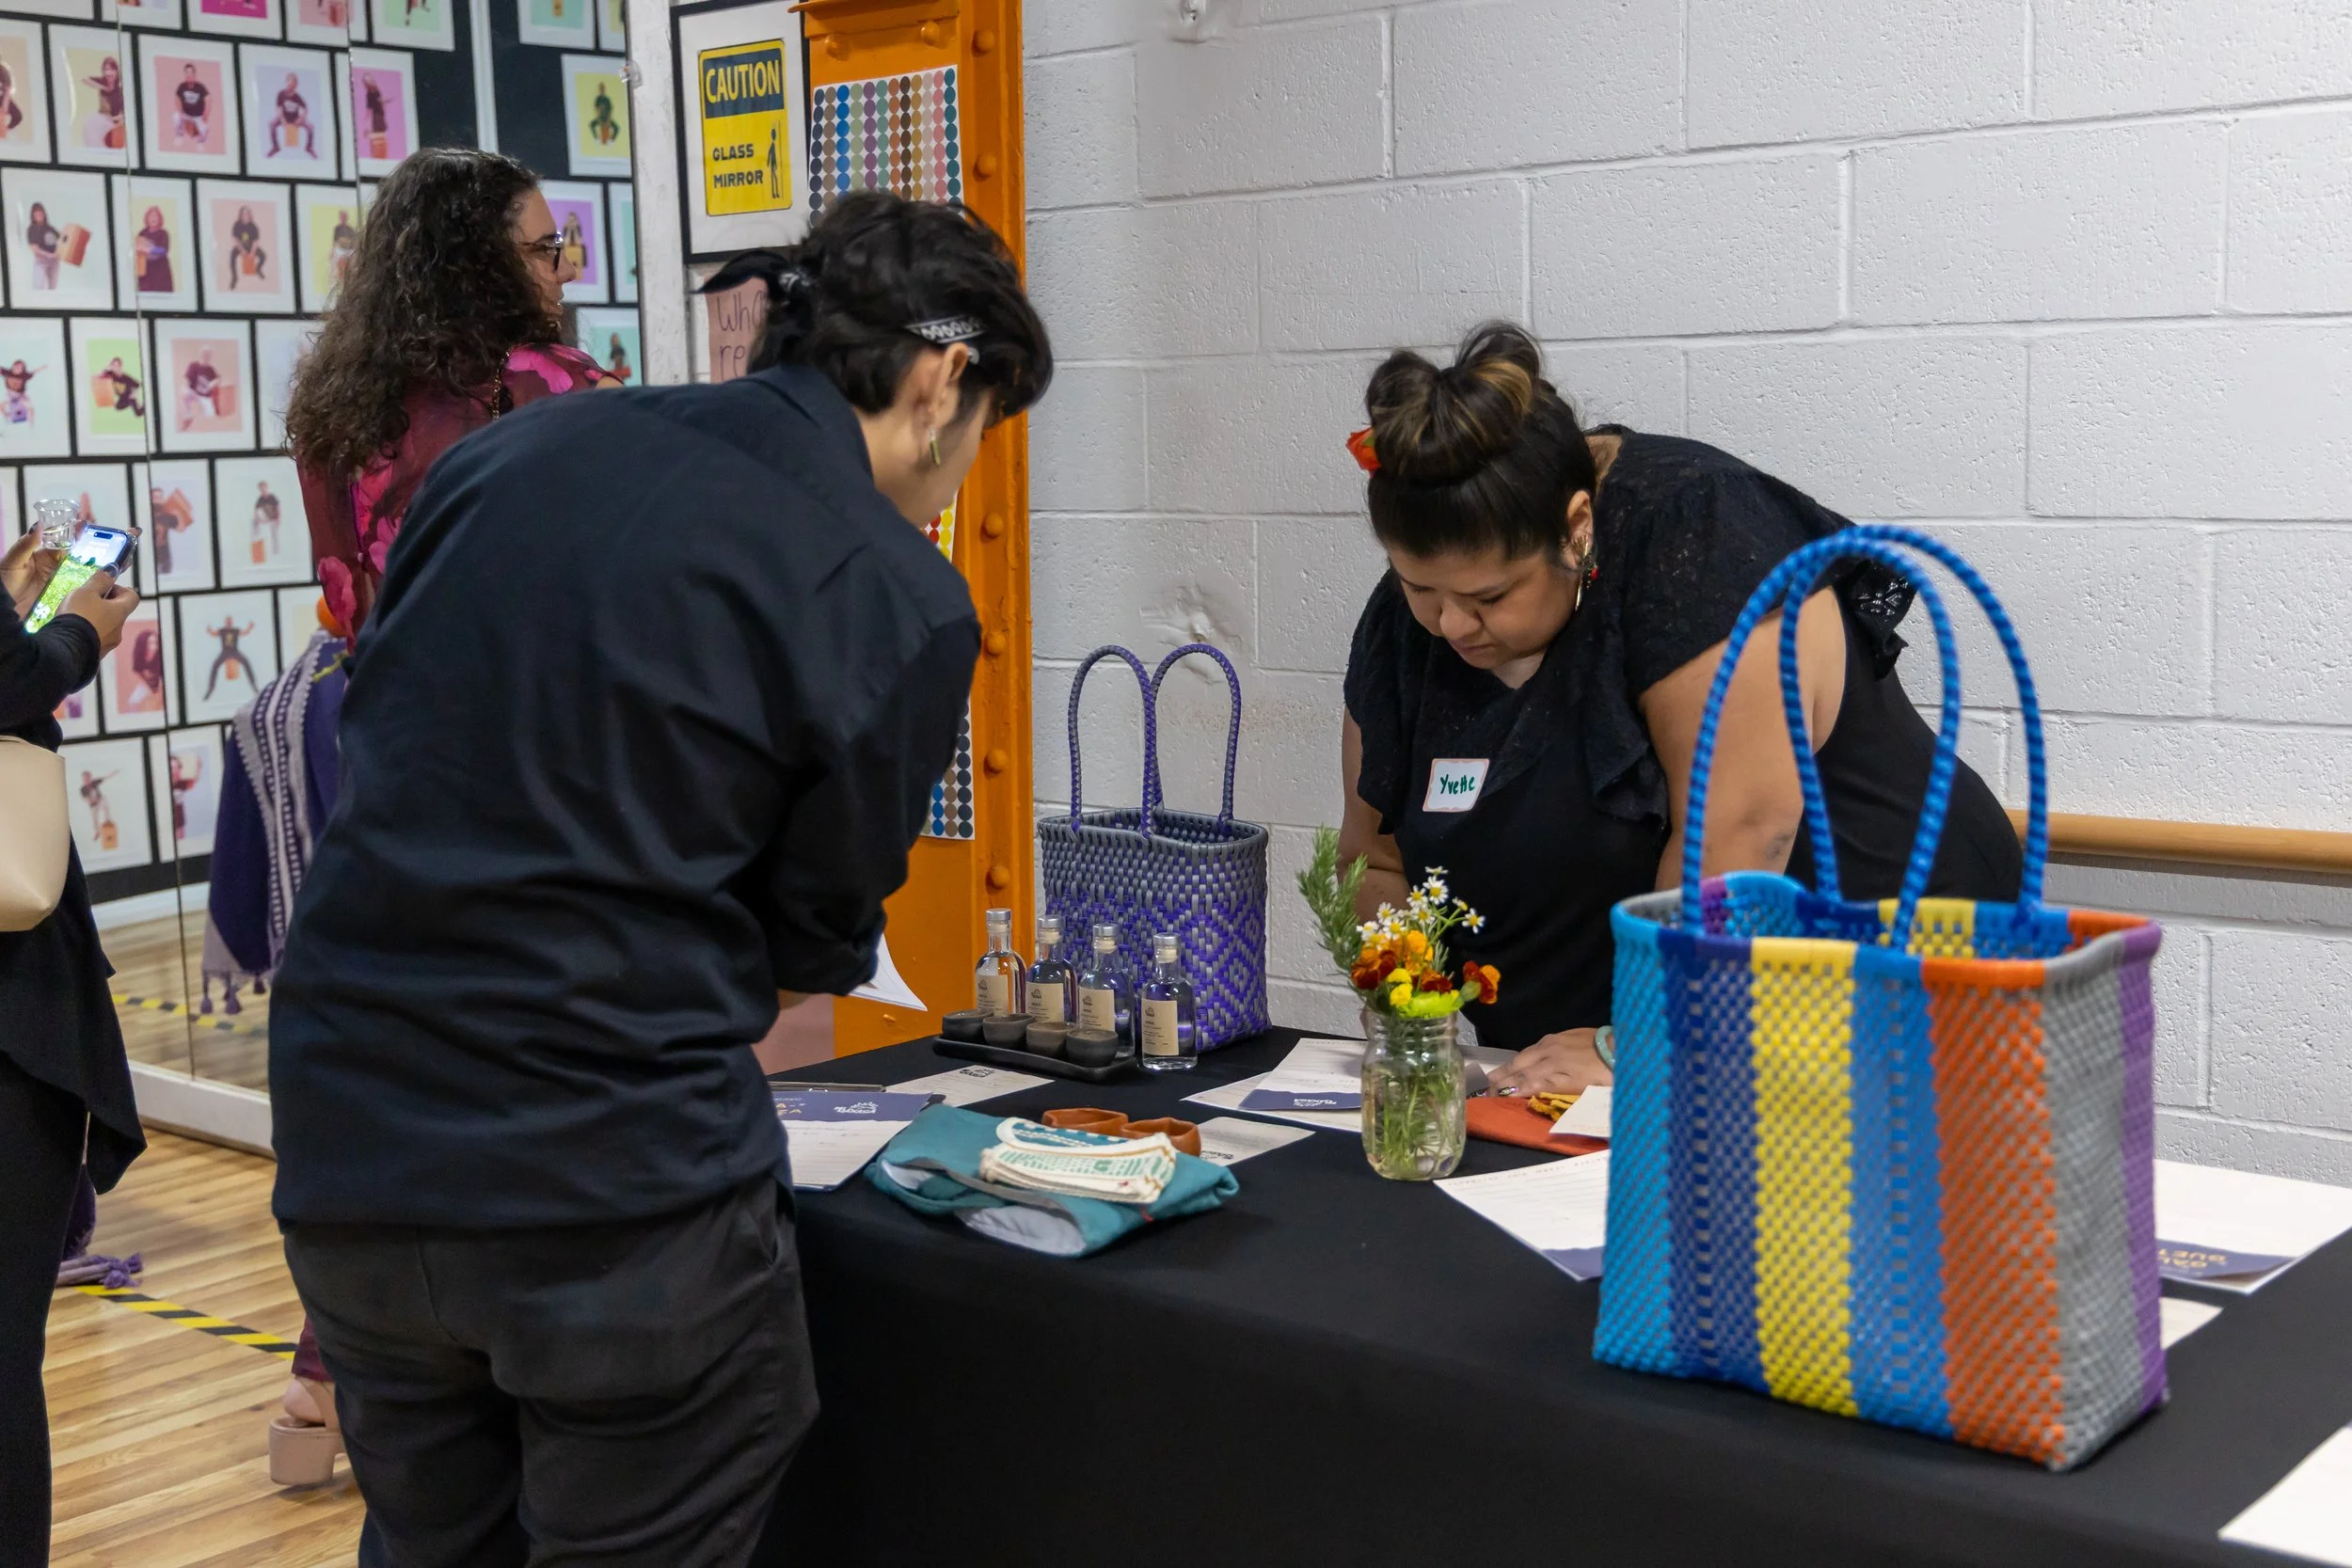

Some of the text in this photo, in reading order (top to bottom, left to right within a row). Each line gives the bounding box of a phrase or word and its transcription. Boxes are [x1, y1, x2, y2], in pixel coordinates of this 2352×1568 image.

[706, 59, 781, 103] CAUTION
[712, 143, 755, 162] GLASS
[713, 169, 764, 189] MIRROR
[1439, 773, 1476, 795] Yvette
